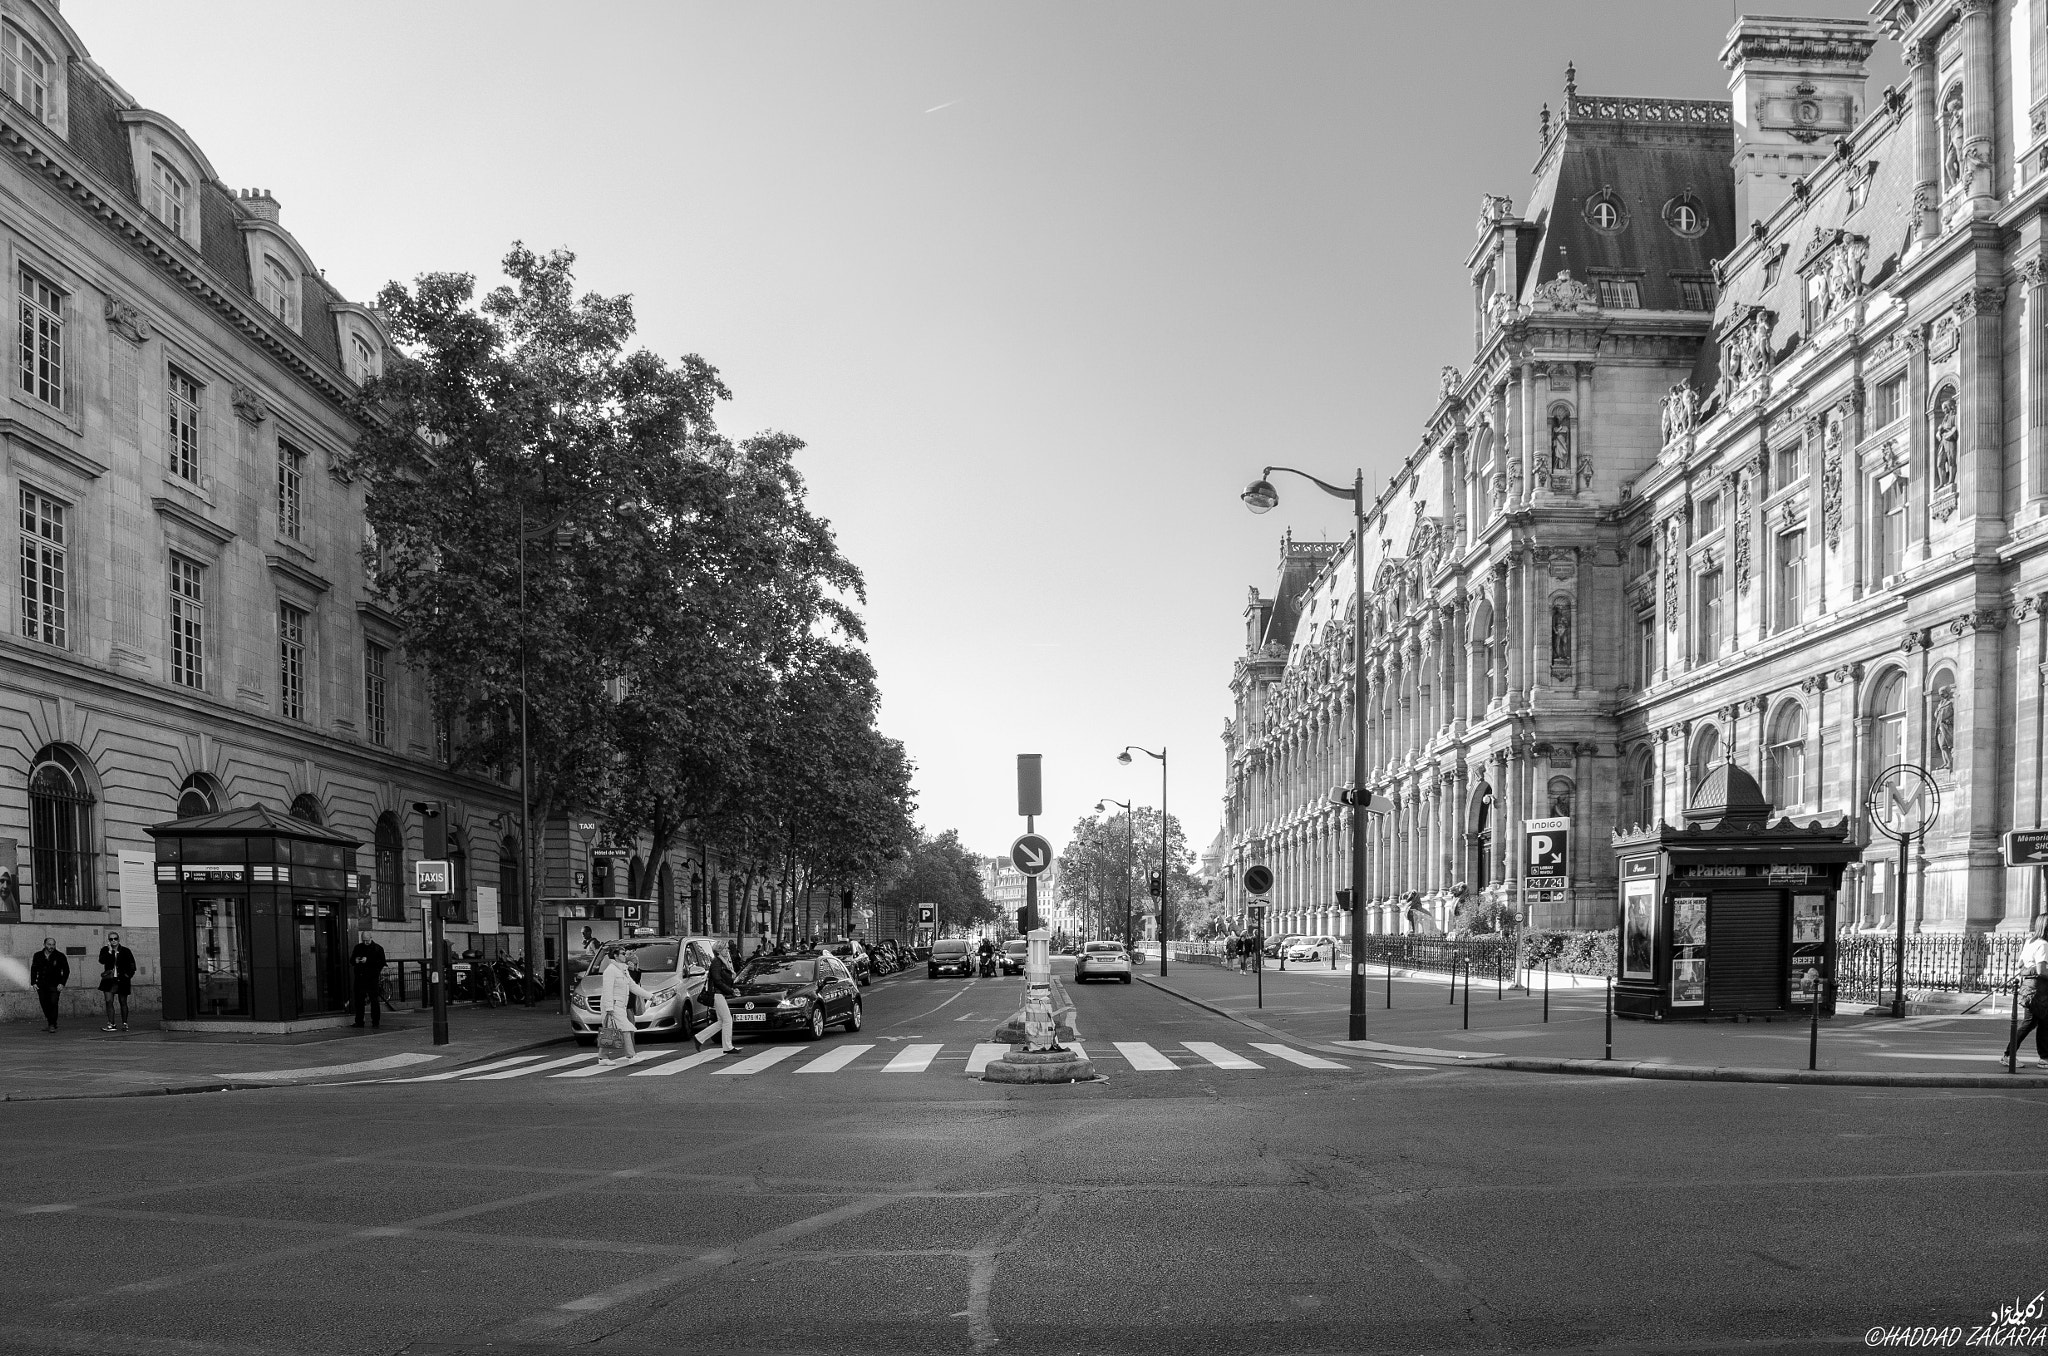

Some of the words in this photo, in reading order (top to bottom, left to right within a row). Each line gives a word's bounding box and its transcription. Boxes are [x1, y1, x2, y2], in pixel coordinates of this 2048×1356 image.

[1884, 781, 1926, 824] M
[1531, 835, 1552, 864] P
[1689, 867, 1696, 877] le
[1697, 864, 1740, 876] Parisien
[184, 872, 190, 880] P
[420, 873, 444, 882] TAXIS
[1530, 878, 1541, 888] 24
[1551, 878, 1562, 888] 24
[628, 907, 636, 917] P
[922, 910, 930, 920] P
[457, 972, 467, 984] P
